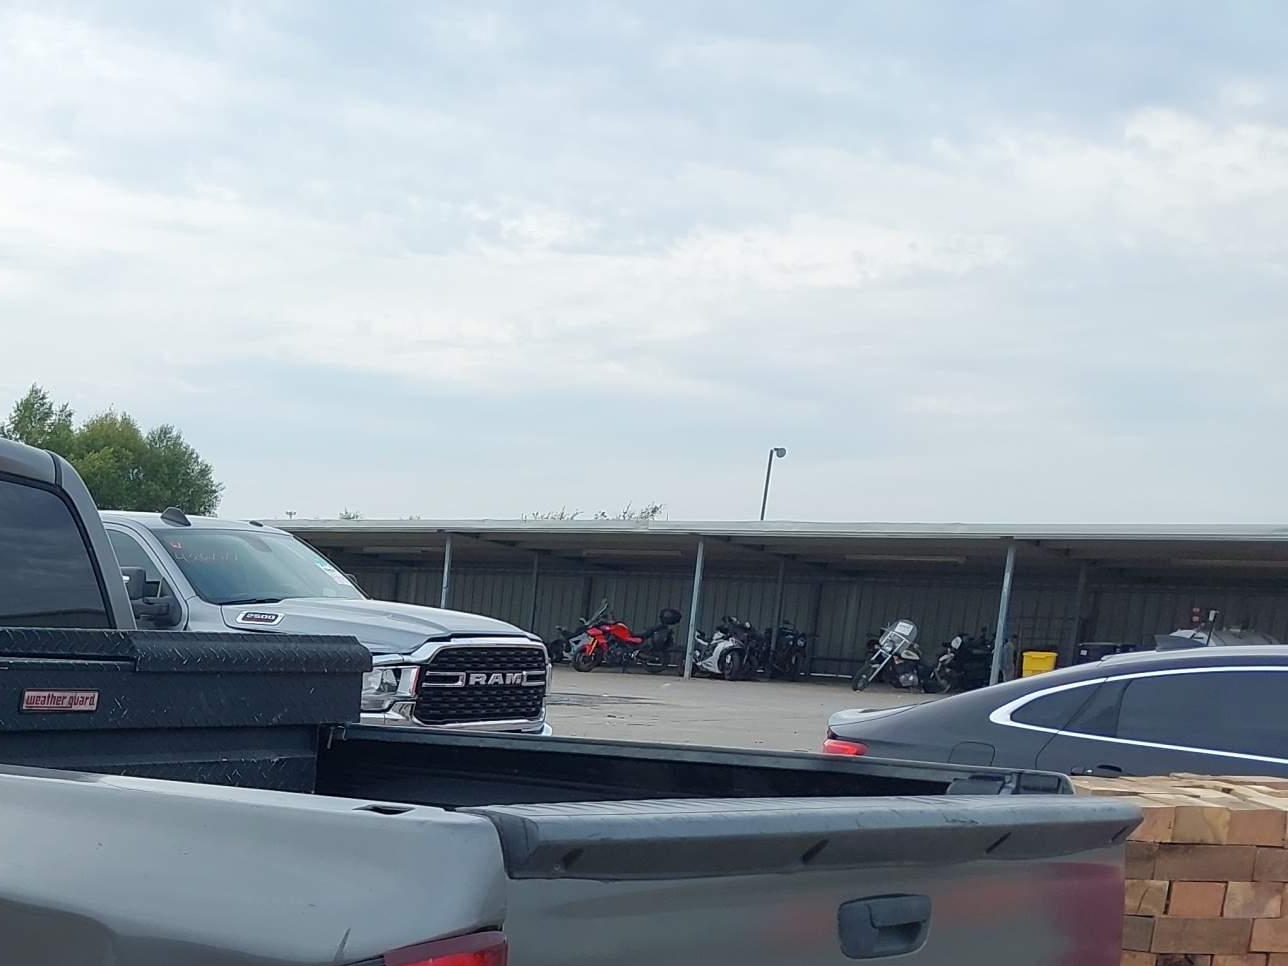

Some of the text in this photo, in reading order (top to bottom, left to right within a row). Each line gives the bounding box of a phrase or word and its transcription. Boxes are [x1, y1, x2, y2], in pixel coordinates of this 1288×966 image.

[245, 613, 276, 621] 2500
[469, 673, 522, 685] RAM
[26, 692, 95, 706] weather guard
